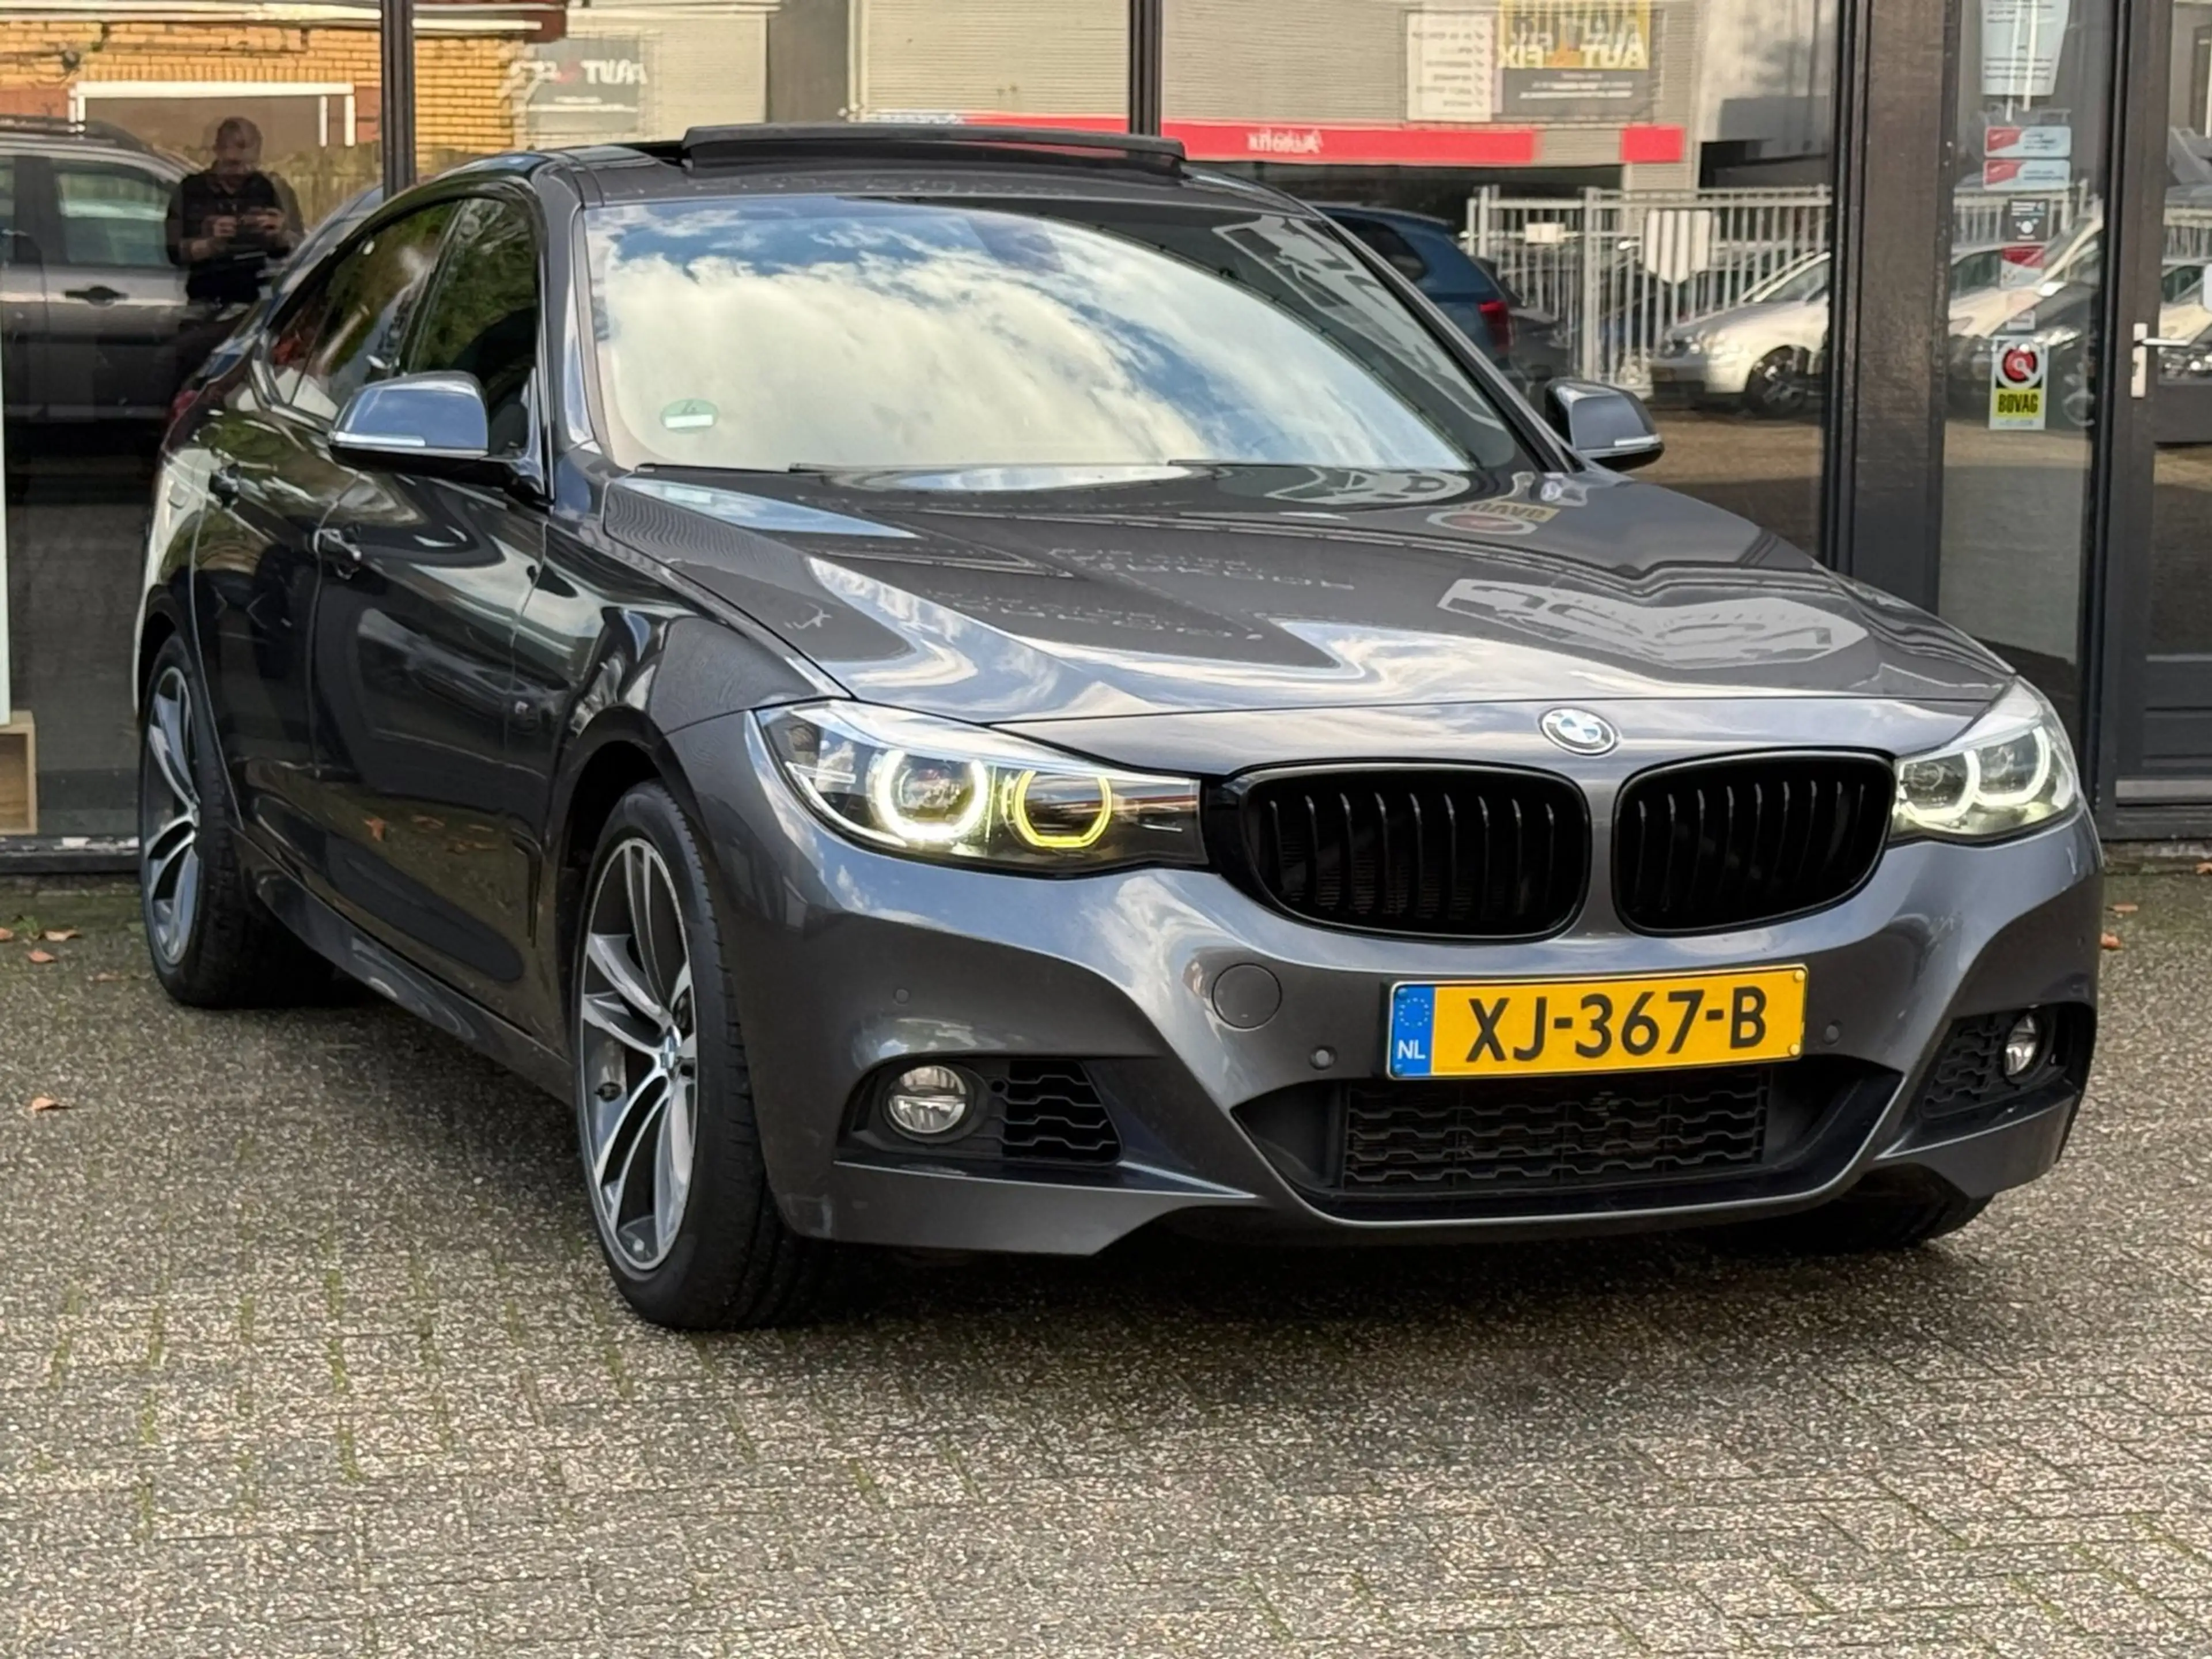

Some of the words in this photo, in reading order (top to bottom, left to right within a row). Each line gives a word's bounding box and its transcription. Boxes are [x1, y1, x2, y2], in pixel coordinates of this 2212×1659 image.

[1998, 394, 2038, 413] BOVAG
[1467, 987, 1767, 1062] XJ-367-B
[1397, 1039, 1426, 1059] NL
